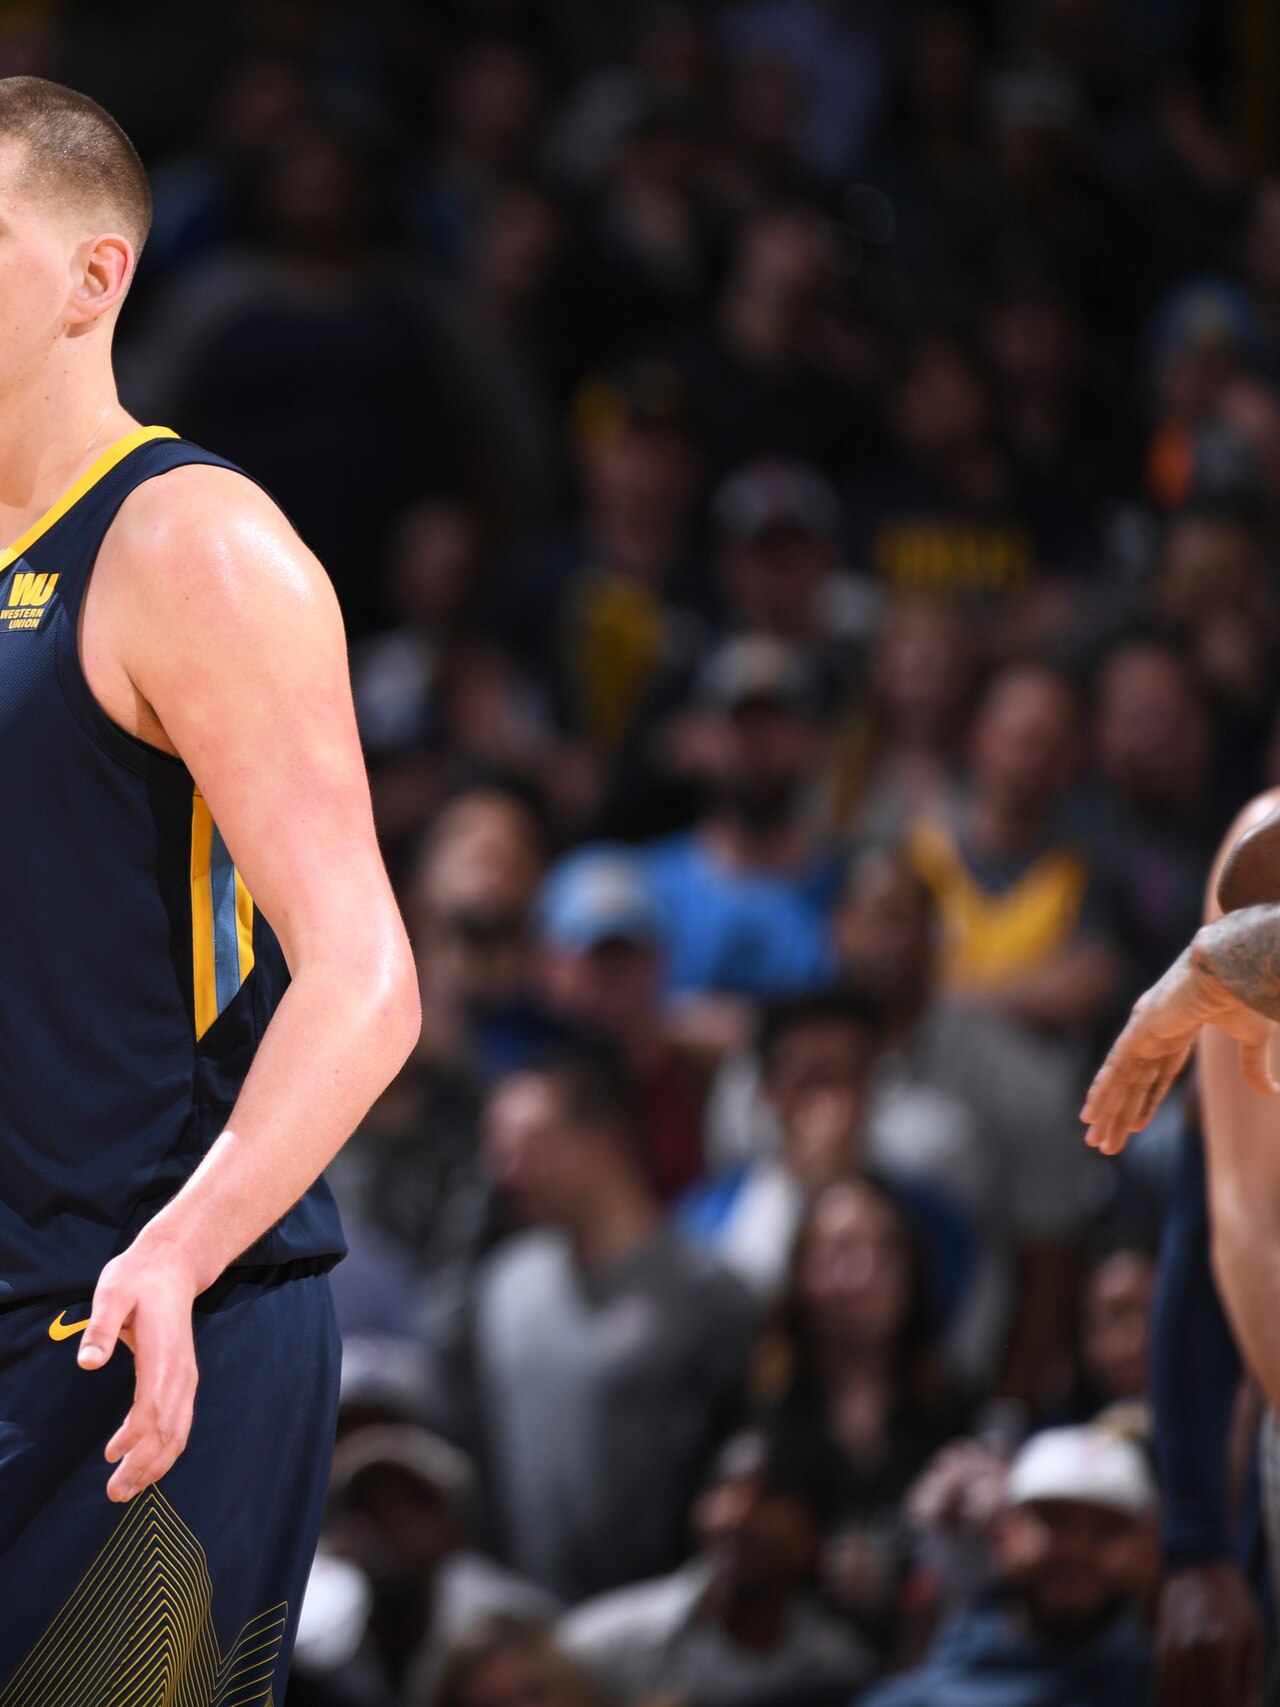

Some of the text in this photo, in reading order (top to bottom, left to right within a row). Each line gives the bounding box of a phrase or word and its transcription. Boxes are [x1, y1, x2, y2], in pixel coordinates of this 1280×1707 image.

[8, 573, 60, 606] WU
[0, 608, 45, 619] WESTERN
[8, 619, 41, 629] UNION
